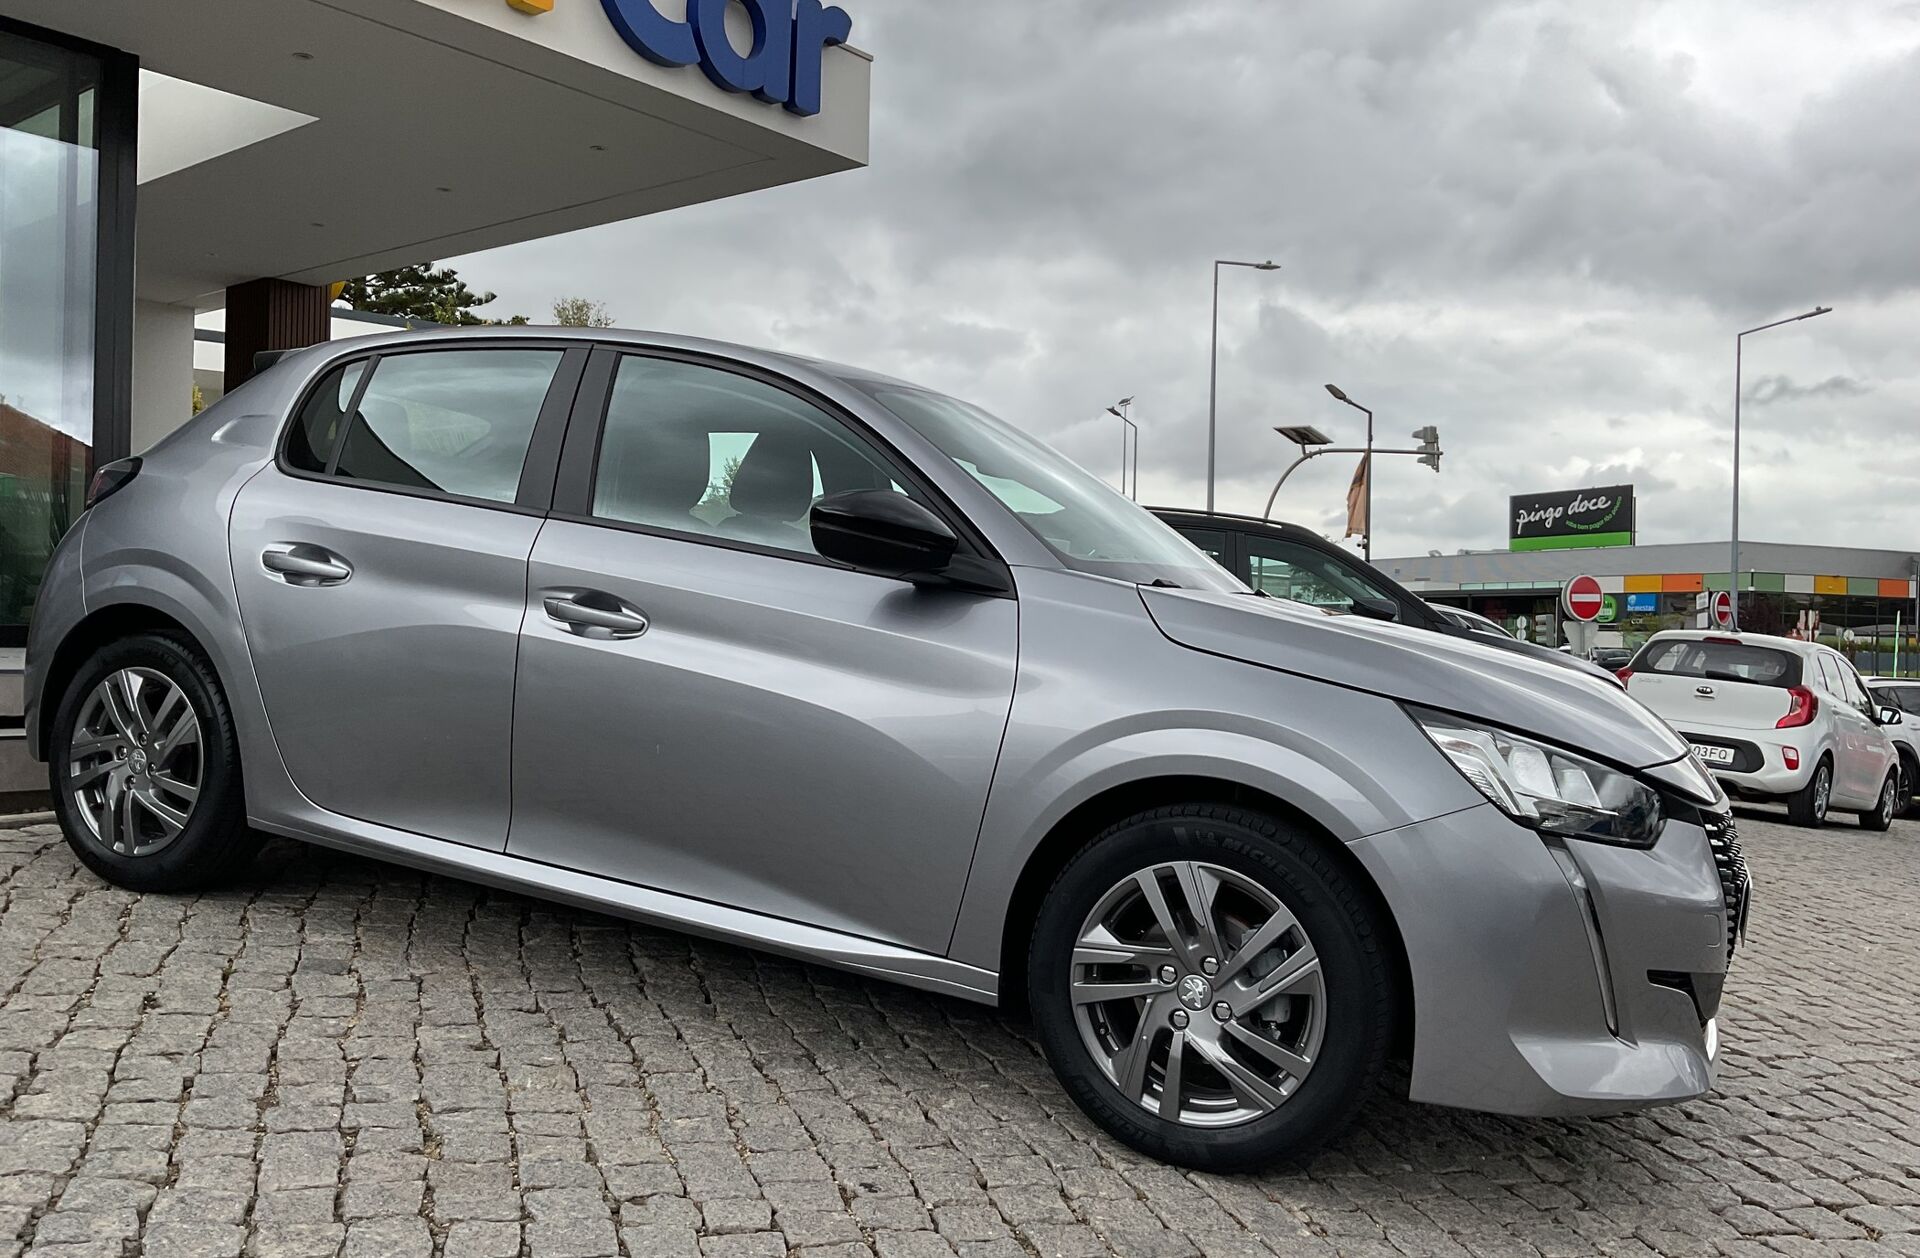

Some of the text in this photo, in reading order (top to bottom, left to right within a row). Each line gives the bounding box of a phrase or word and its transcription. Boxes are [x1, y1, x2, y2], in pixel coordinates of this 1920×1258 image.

[1516, 494, 1612, 535] pingo doce
[1222, 838, 1316, 905] MICHELIN
